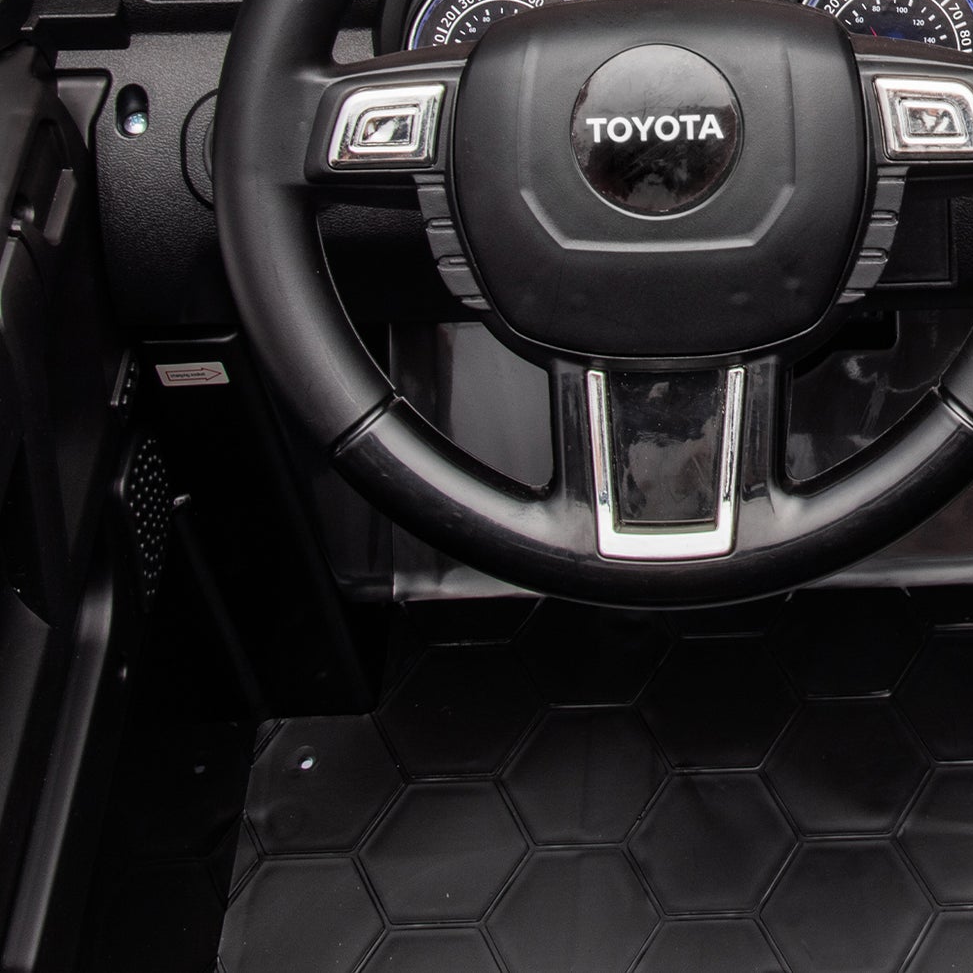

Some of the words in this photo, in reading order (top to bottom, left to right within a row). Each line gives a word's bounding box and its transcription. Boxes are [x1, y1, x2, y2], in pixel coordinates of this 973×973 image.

[895, 6, 909, 14] 100
[948, 2, 964, 20] 70
[440, 11, 457, 28] 20
[912, 19, 925, 27] 120
[432, 33, 445, 47] 0
[923, 36, 936, 44] 140
[959, 30, 973, 46] 80
[586, 114, 724, 143] TOYOTA
